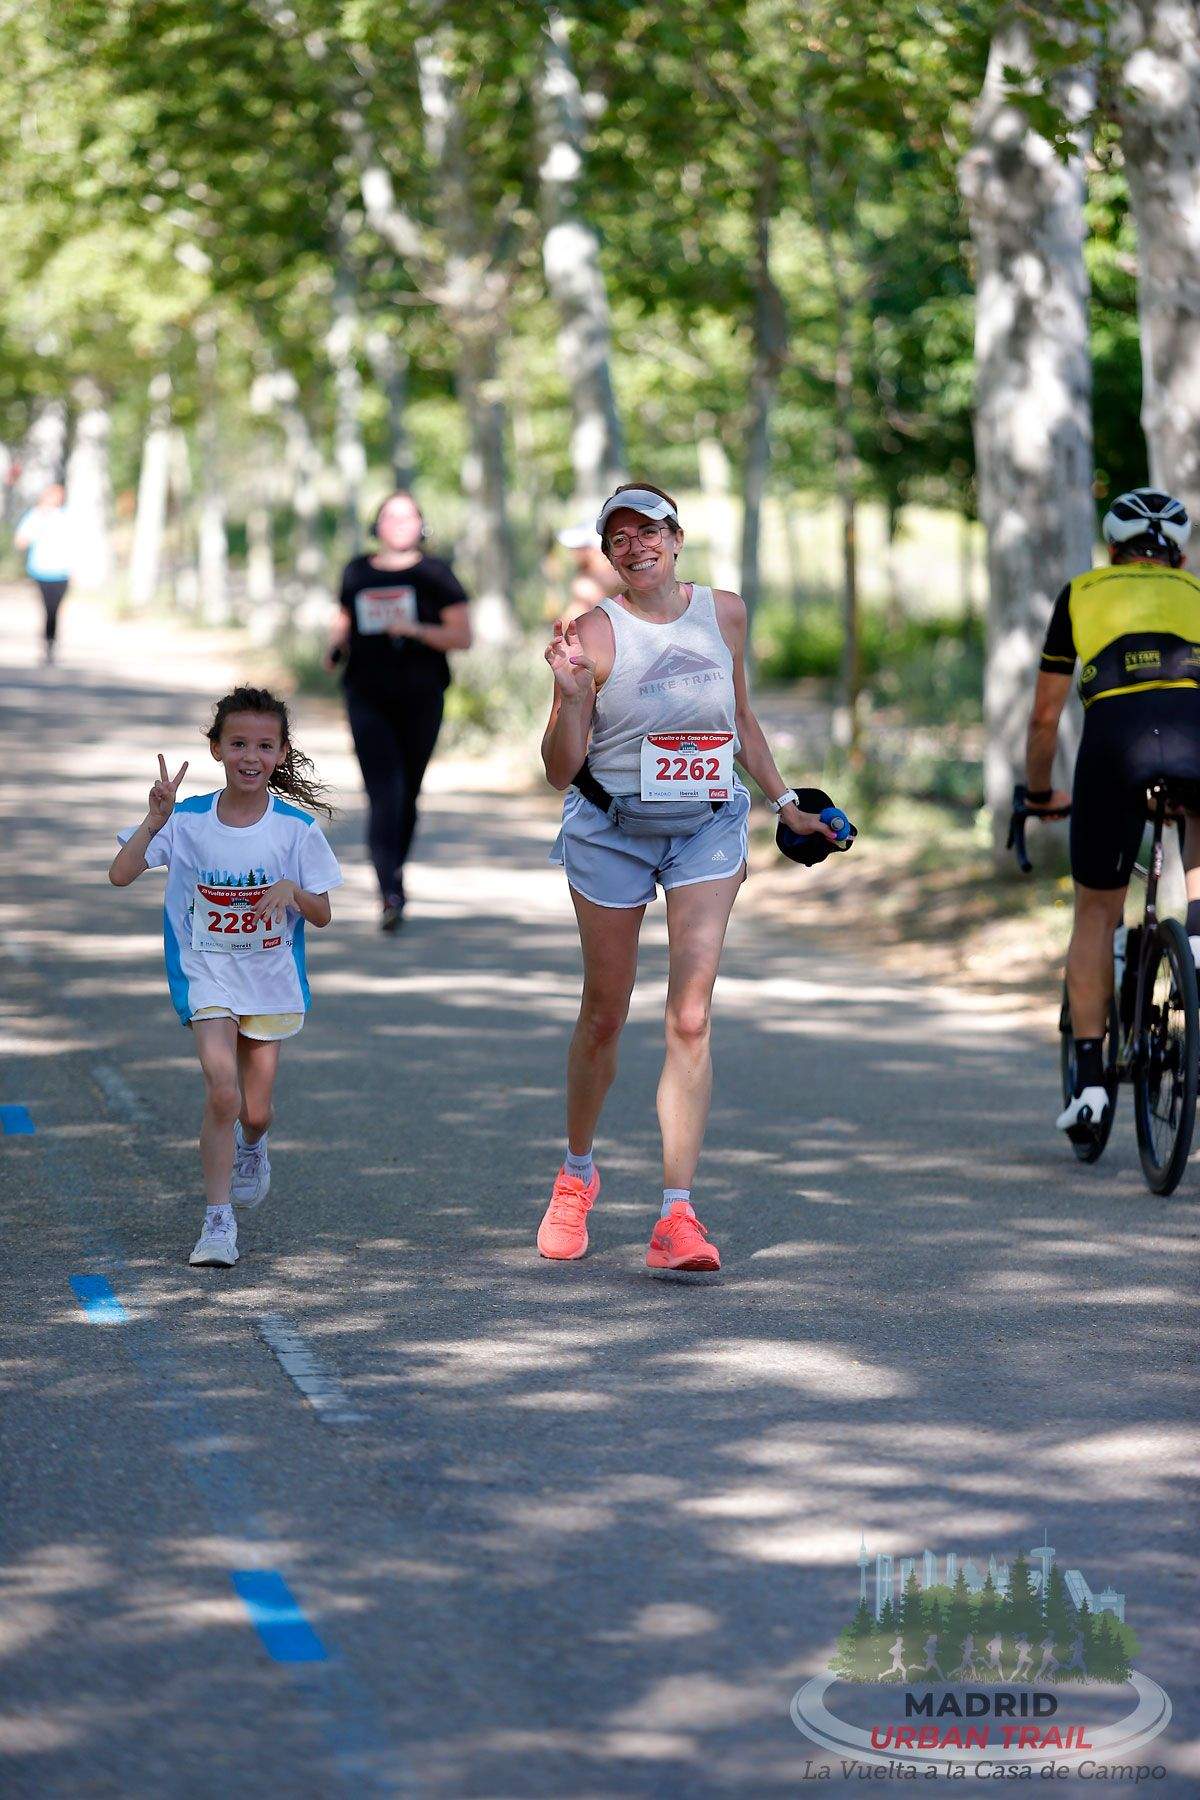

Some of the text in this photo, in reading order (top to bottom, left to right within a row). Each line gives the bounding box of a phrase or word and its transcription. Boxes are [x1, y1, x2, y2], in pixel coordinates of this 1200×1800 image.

[639, 671, 724, 695] NIKE TRAIL
[656, 757, 720, 780] 2262
